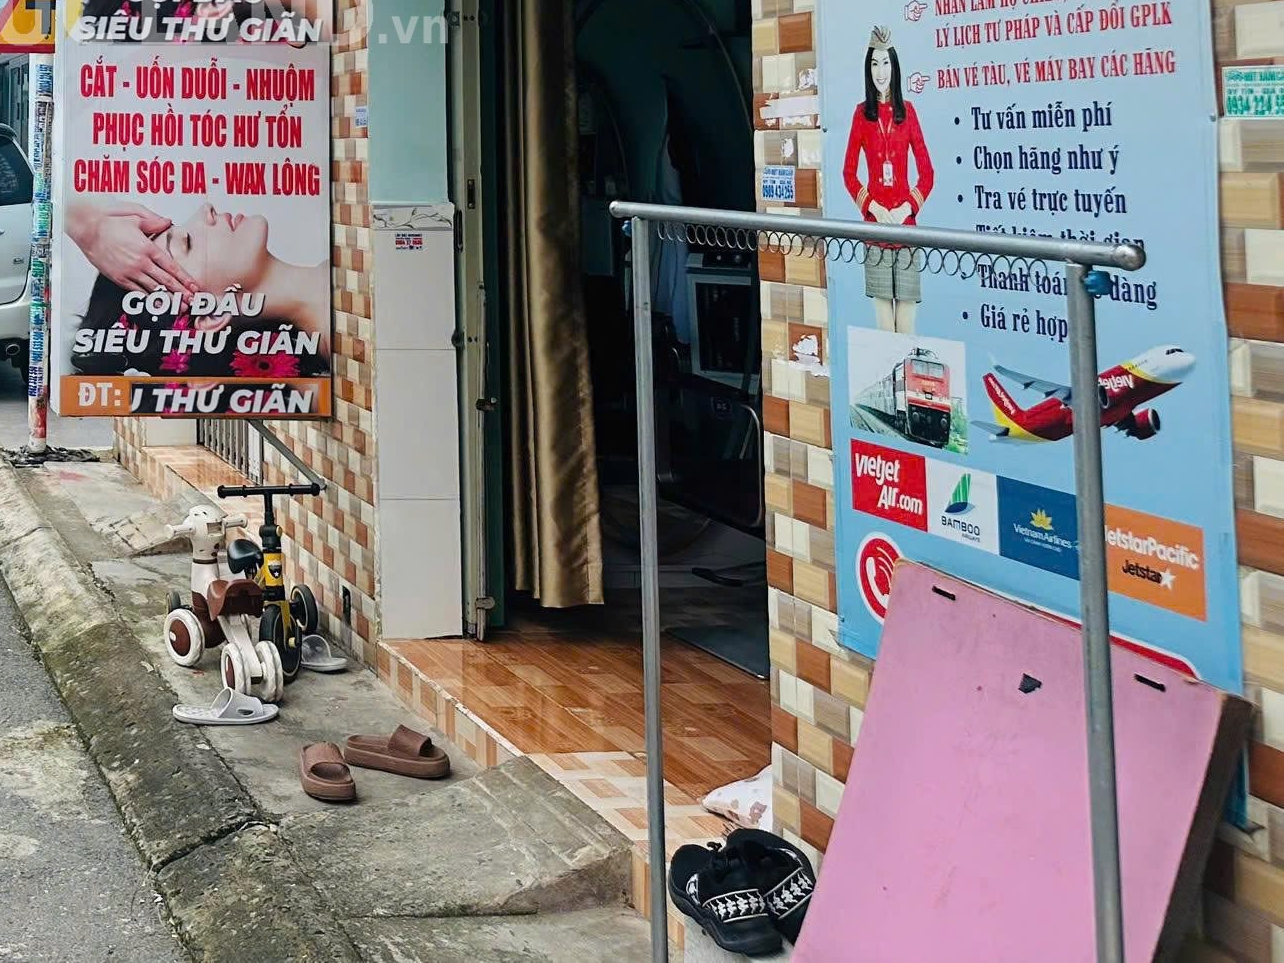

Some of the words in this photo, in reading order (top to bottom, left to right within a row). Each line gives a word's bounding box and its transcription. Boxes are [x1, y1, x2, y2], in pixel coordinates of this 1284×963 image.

[78, 10, 153, 41] SIÊU
[163, 15, 232, 42] THƯ
[239, 11, 324, 43] GIÃN
[936, 23, 950, 48] LÝ
[953, 24, 981, 49] LỊCH
[984, 19, 1002, 43] TƯ
[1005, 13, 1040, 41] PHÁP
[1044, 10, 1062, 36] VÀ
[1066, 4, 1094, 34] CẤP
[80, 55, 117, 98] CẮT
[136, 55, 174, 99] UỐN
[181, 57, 227, 100] DUỖI
[246, 63, 315, 106] NHUỘM
[937, 64, 960, 89] BÁN
[964, 62, 979, 87] VÉ
[982, 60, 1011, 87] TÀU,
[1014, 57, 1031, 84] VÉ
[1034, 55, 1063, 82] MÁY
[1068, 56, 1096, 80] BAY
[1101, 49, 1128, 78] CÁC
[92, 112, 144, 152] PHỤC
[150, 103, 184, 146] HỒI
[190, 109, 227, 148] TÓC
[233, 110, 262, 148] HƯ
[265, 104, 302, 148] TỔN
[971, 106, 991, 130] Tư
[996, 103, 1026, 130] vấn
[1032, 101, 1076, 129] miễn
[1082, 100, 1113, 132] phí
[74, 154, 130, 193] CHĂM
[136, 156, 174, 194] SÓC
[181, 162, 207, 194] DA
[225, 162, 267, 195] WAX
[272, 157, 321, 196] LÔNG
[973, 145, 1014, 174] Chọn
[1018, 145, 1062, 175] hãng
[1067, 143, 1104, 170] như
[1109, 144, 1120, 175] ý
[975, 185, 1003, 209] Tra
[1007, 187, 1026, 211] vé
[1032, 188, 1068, 216] trực
[1074, 186, 1127, 218] tuyến
[121, 284, 184, 322] GỘI
[190, 283, 266, 317] ĐẦU
[977, 263, 1030, 293] Thanh
[1035, 271, 1068, 296] toá
[1110, 274, 1158, 311] dàng
[72, 322, 151, 354] SIÊU
[158, 328, 232, 355] THƯ
[236, 323, 320, 356] GIÃN
[980, 303, 1007, 331] Giá
[1012, 308, 1030, 333] rẻ
[1036, 309, 1068, 343] hợp
[77, 382, 121, 407] ĐT:
[152, 384, 225, 413] THƯ
[229, 383, 314, 414] GIÃN
[941, 515, 981, 537] BAMBOO
